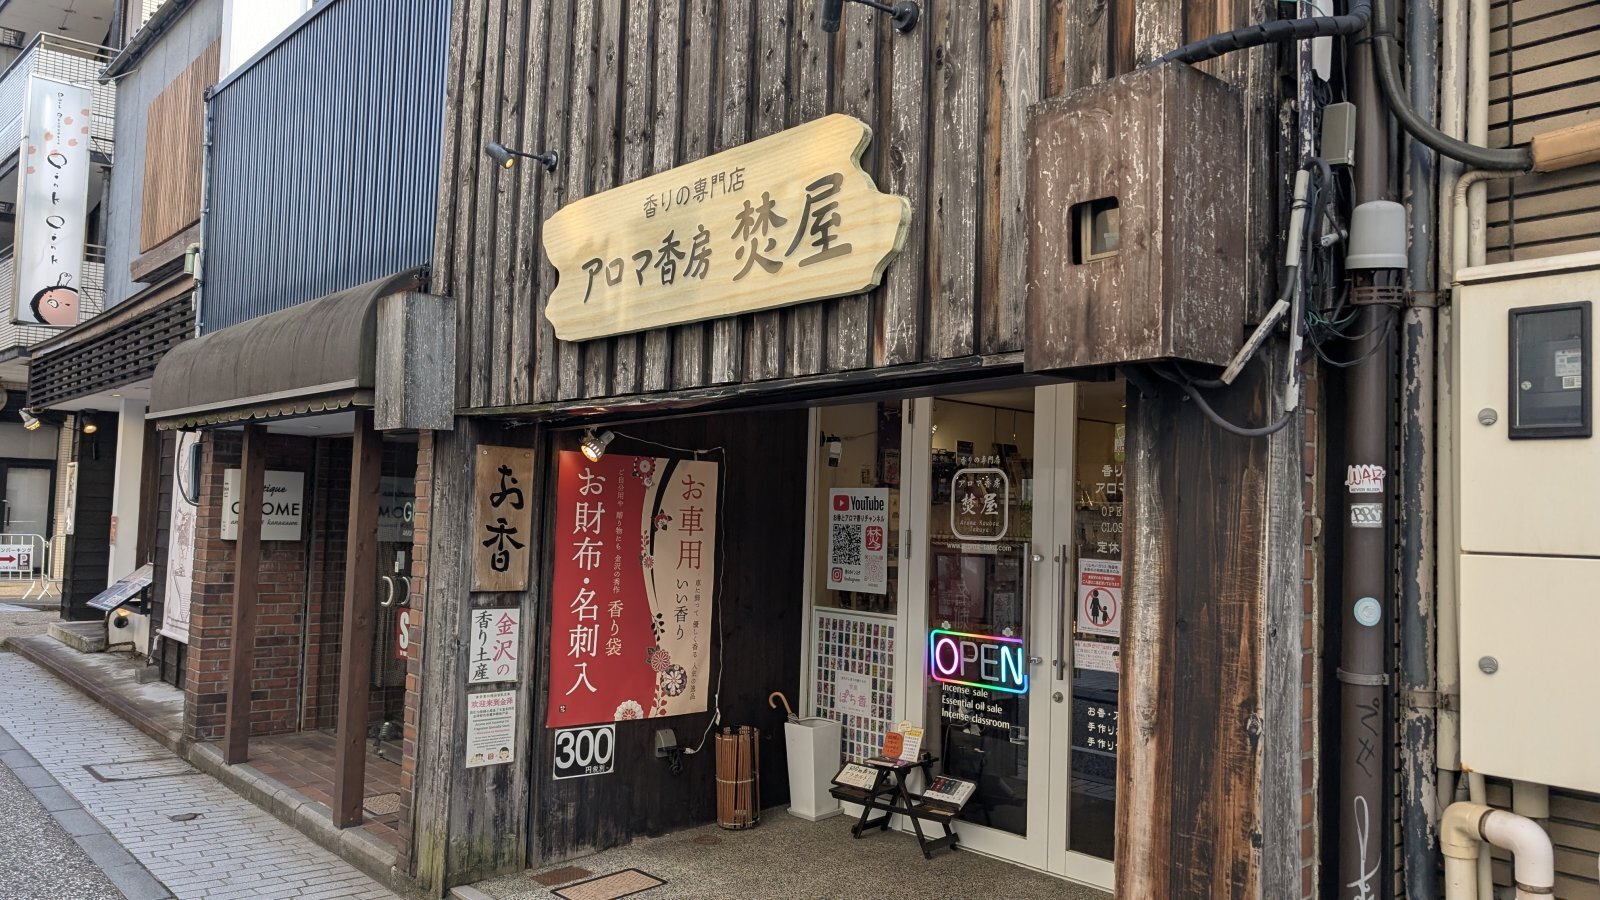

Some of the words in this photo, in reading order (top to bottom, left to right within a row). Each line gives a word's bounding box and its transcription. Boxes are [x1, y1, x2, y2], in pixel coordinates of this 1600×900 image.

[643, 166, 746, 219] 香りの専門店
[581, 224, 712, 303] アロマ香房
[731, 172, 853, 282] 焚屋
[850, 495, 885, 511] YouTube
[958, 478, 1001, 488] アロマ香房
[961, 492, 999, 515] 焚屋
[482, 464, 526, 573] お香
[676, 474, 705, 570] お車用
[565, 467, 606, 696] お財布・名刺入
[605, 599, 624, 657] 香り袋
[673, 578, 689, 641] いい香り
[472, 610, 493, 681] 香り土産
[492, 612, 519, 676] 金沢の
[935, 637, 1024, 685] OPEN
[941, 695, 974, 709] Essential
[975, 701, 986, 711] oil
[986, 704, 1003, 714] sale
[942, 682, 970, 695] Incense
[972, 688, 988, 698] sale
[941, 708, 970, 722] Incense
[971, 713, 1010, 730] classroom
[1087, 737, 1118, 751] 手作り
[555, 727, 613, 769] 300
